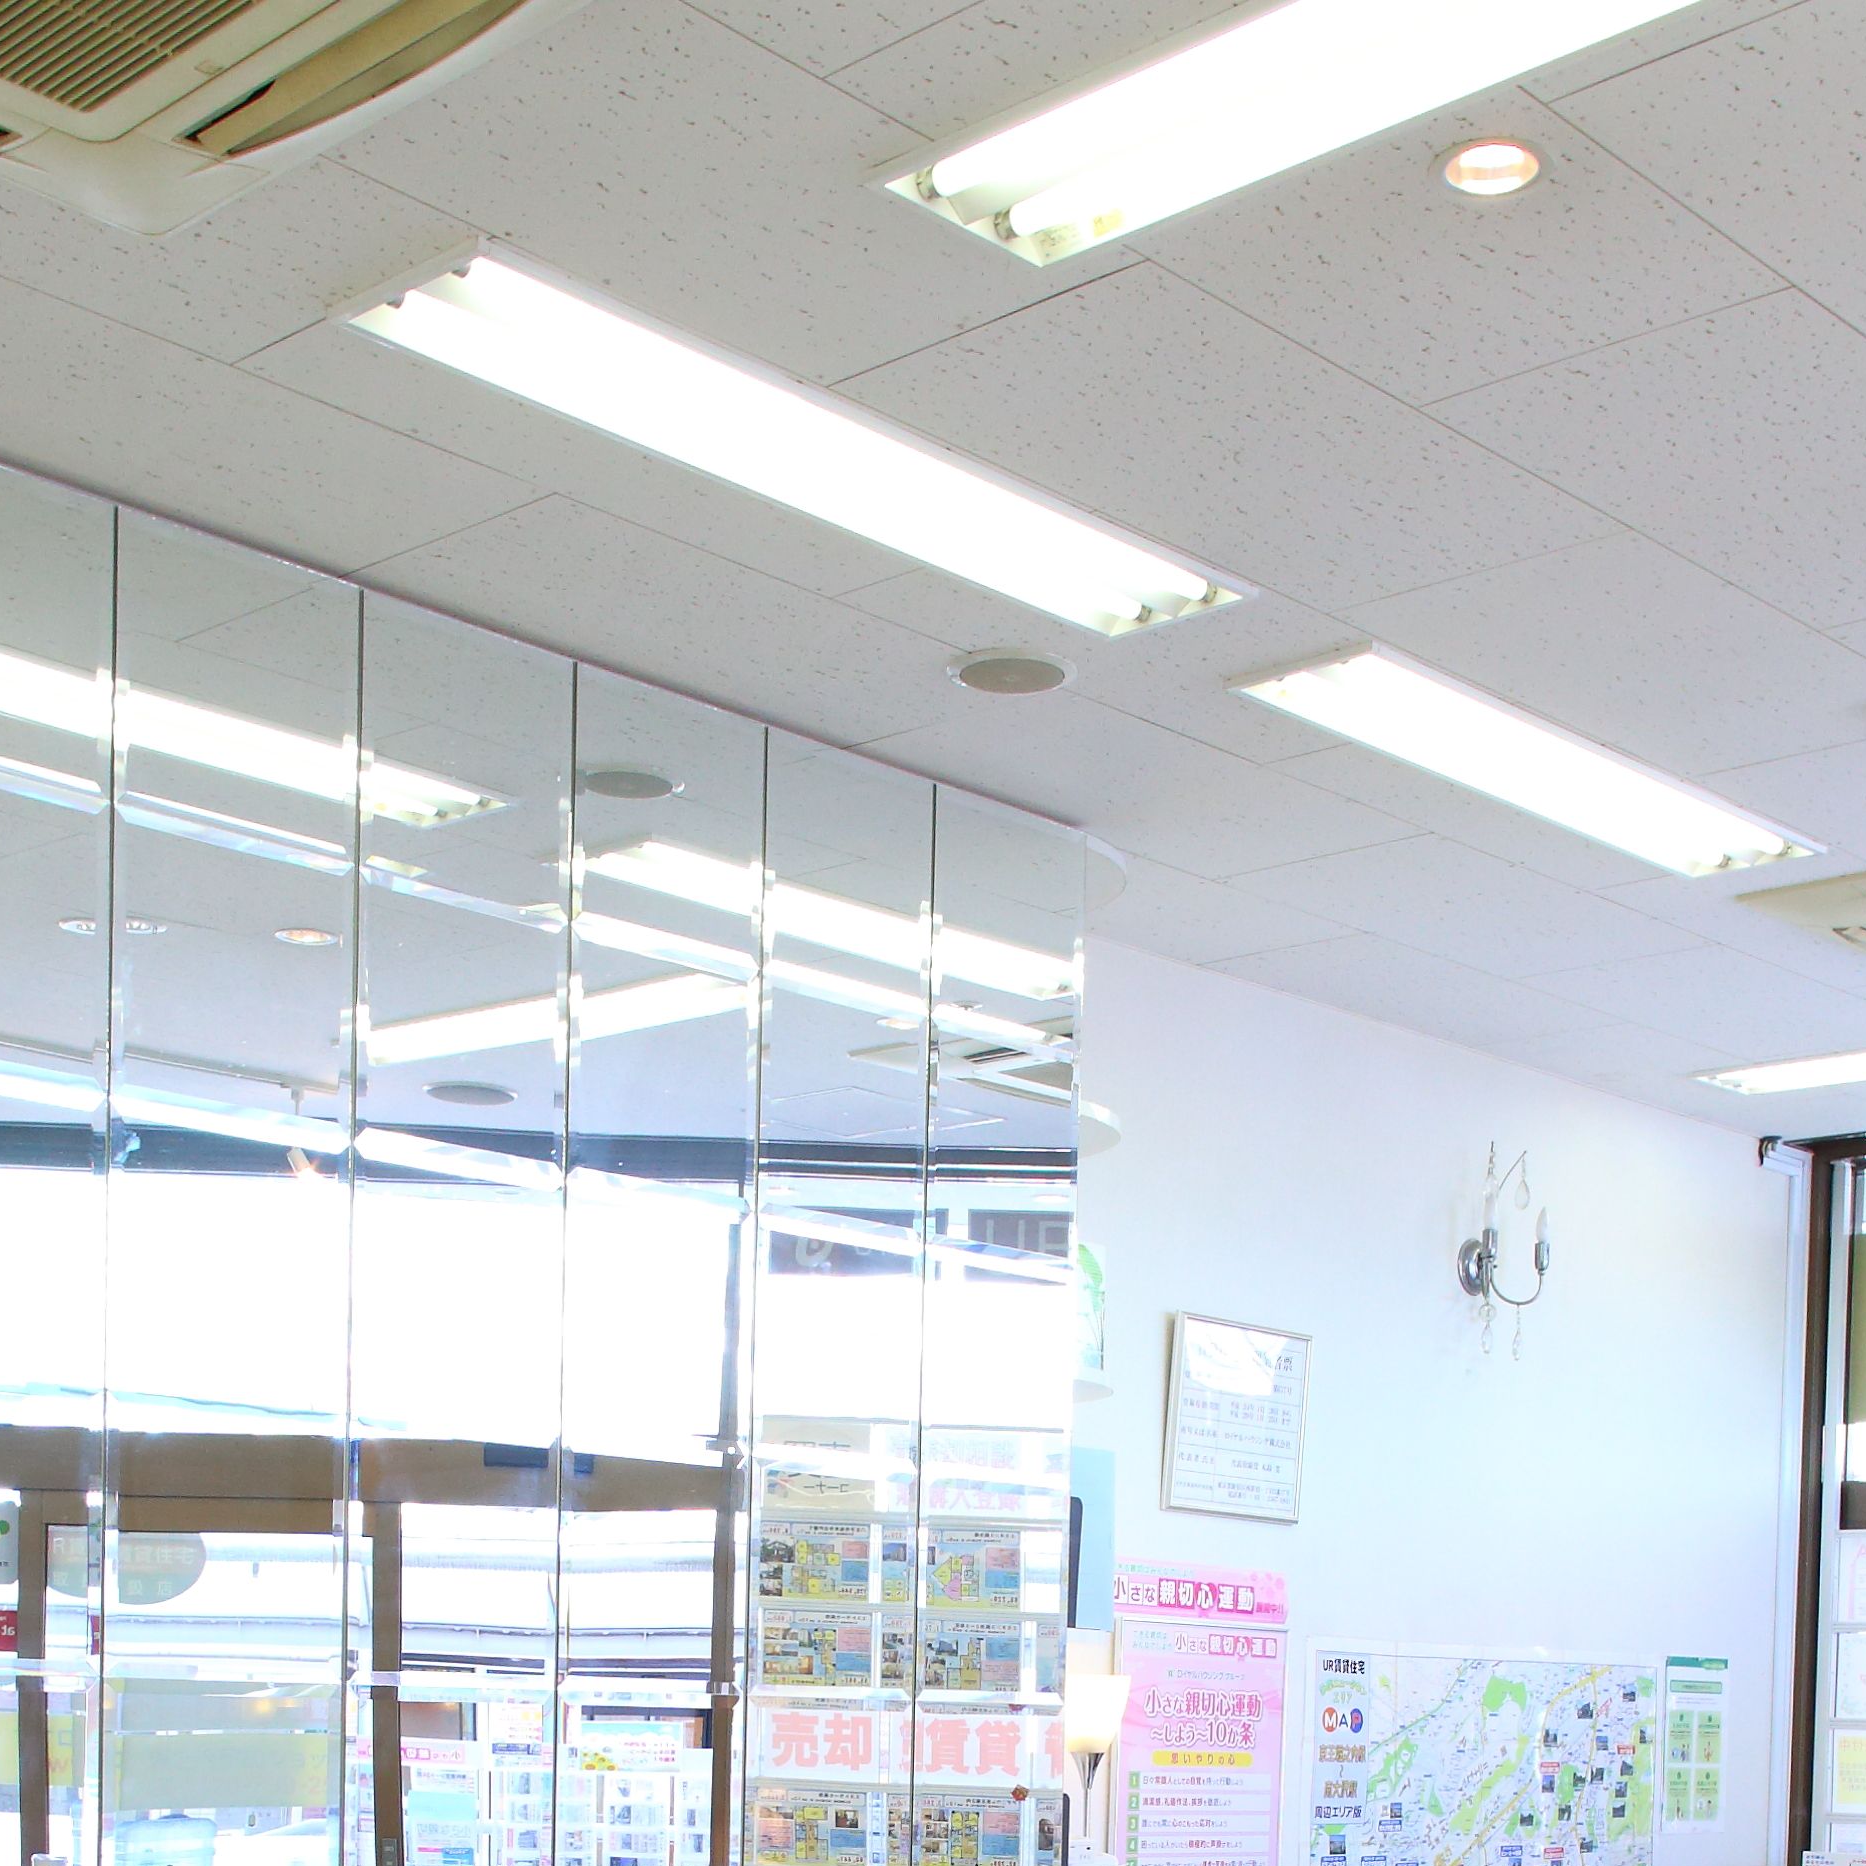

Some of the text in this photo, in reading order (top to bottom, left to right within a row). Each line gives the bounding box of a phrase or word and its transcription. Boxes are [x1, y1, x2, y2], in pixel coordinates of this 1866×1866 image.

[1114, 1575, 1255, 1614] 小さな親切心運動
[1174, 1631, 1278, 1658] 小さな親切心運動
[1322, 1657, 1366, 1675] UR賃貸住宅
[1144, 1687, 1262, 1720] 小さな親切心運動
[1322, 1706, 1363, 1733] MAP
[771, 1711, 1021, 1777] 売却 賃貸
[1170, 1751, 1236, 1766] 思いやりの心
[1313, 1804, 1363, 1819] 周辺エリア版
